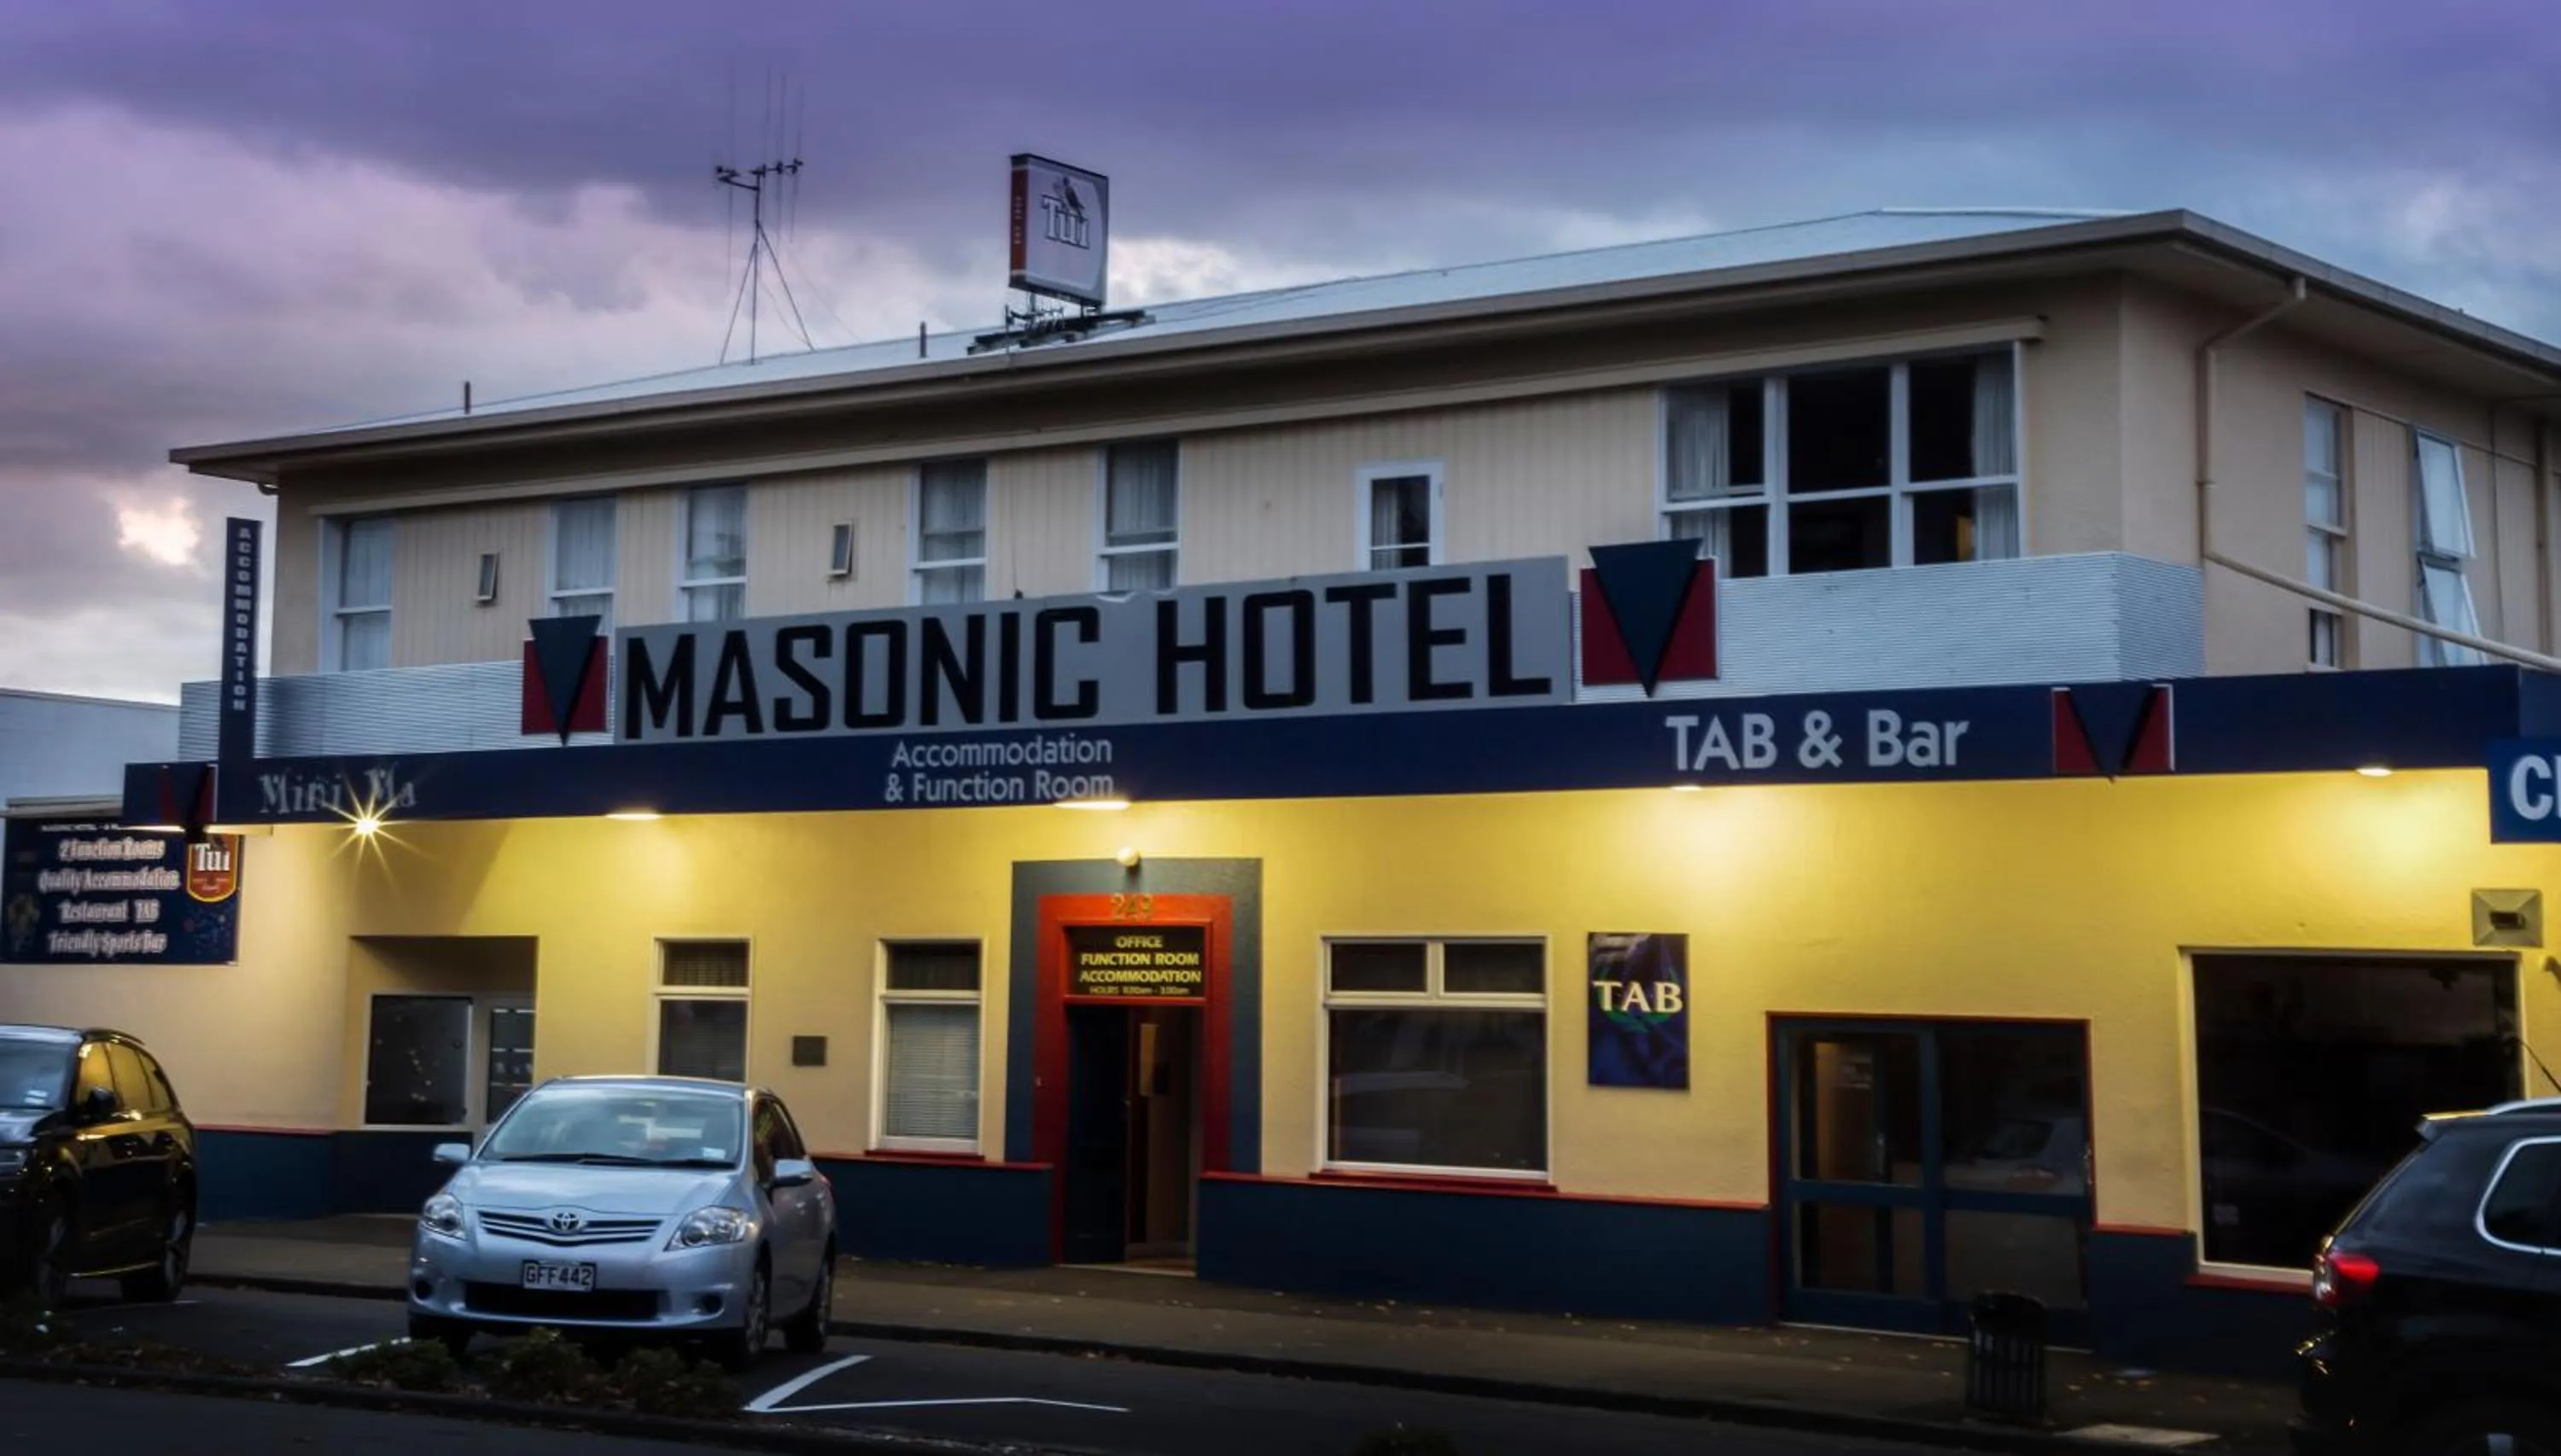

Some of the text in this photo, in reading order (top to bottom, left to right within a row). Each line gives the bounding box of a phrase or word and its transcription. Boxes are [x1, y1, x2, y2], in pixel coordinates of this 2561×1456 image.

[1041, 194, 1090, 249] Tui
[233, 527, 252, 711] ACCOMMODATION
[625, 574, 1551, 739] MASONIC HOTEL
[891, 733, 1112, 767] Accommodation
[1666, 709, 1969, 771] TAB & Bar
[260, 772, 341, 813] Mini
[884, 769, 1114, 802] & Function Room
[195, 843, 230, 871] Tui
[38, 869, 83, 895] Quality
[85, 866, 180, 890] Accommodation
[58, 900, 127, 923] Restaurant
[49, 930, 99, 955] Friendly
[102, 931, 142, 956] Sports
[1116, 936, 1163, 948] OFFICE
[1081, 952, 1199, 965] FUNCTION ROOM
[1080, 970, 1201, 982] ACCOMMODATION
[1592, 981, 1683, 1013] TAB
[525, 1265, 592, 1287] GFF442
